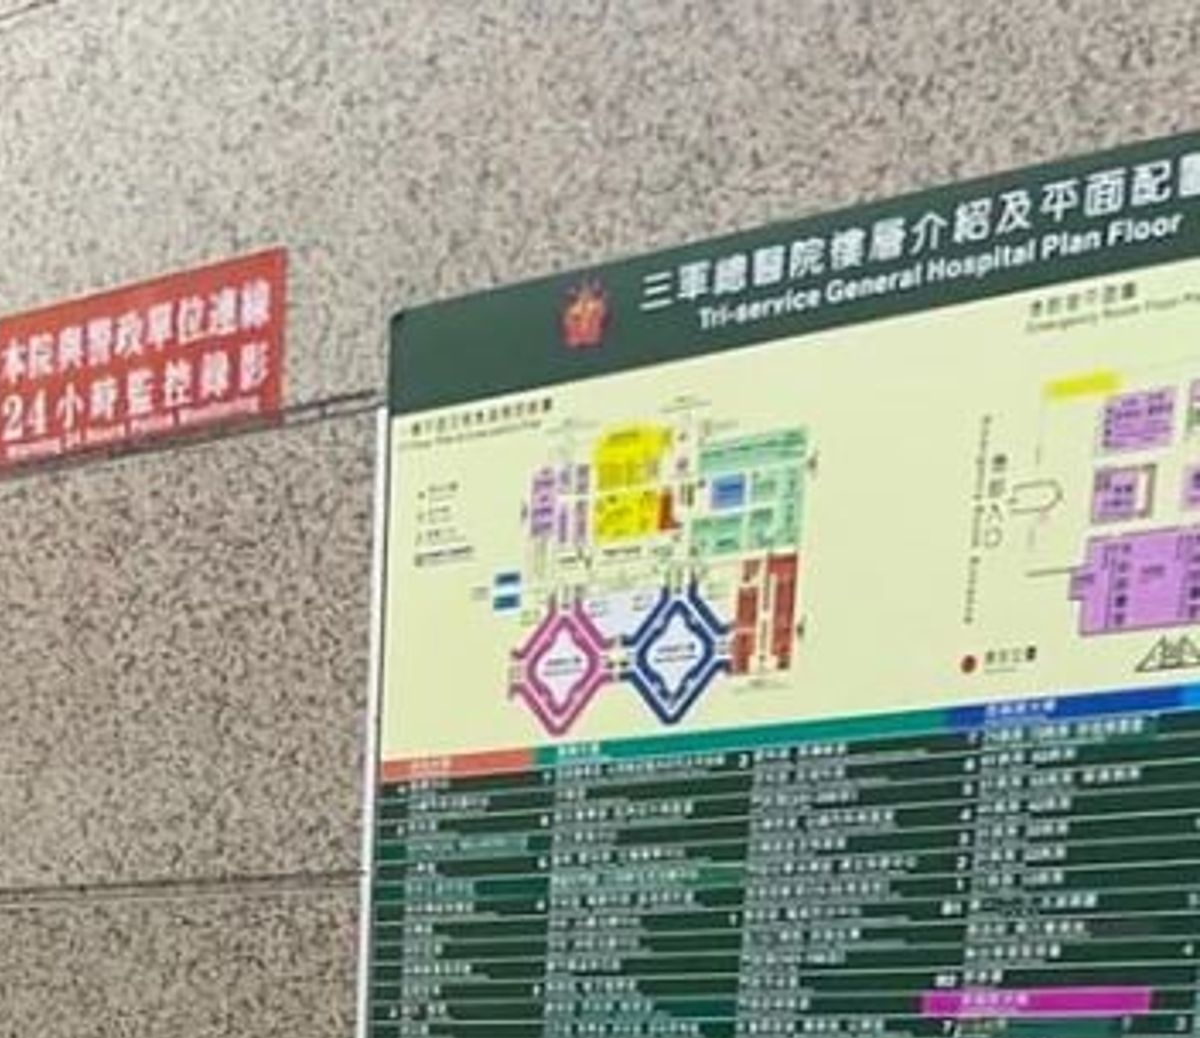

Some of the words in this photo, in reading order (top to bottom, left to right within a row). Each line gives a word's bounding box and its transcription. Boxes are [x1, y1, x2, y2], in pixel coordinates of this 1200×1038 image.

[700, 288, 820, 329] Tri-service
[826, 262, 921, 302] General
[926, 238, 1037, 281] Hospital
[1041, 230, 1102, 260] Plan
[1107, 213, 1184, 246] Floor
